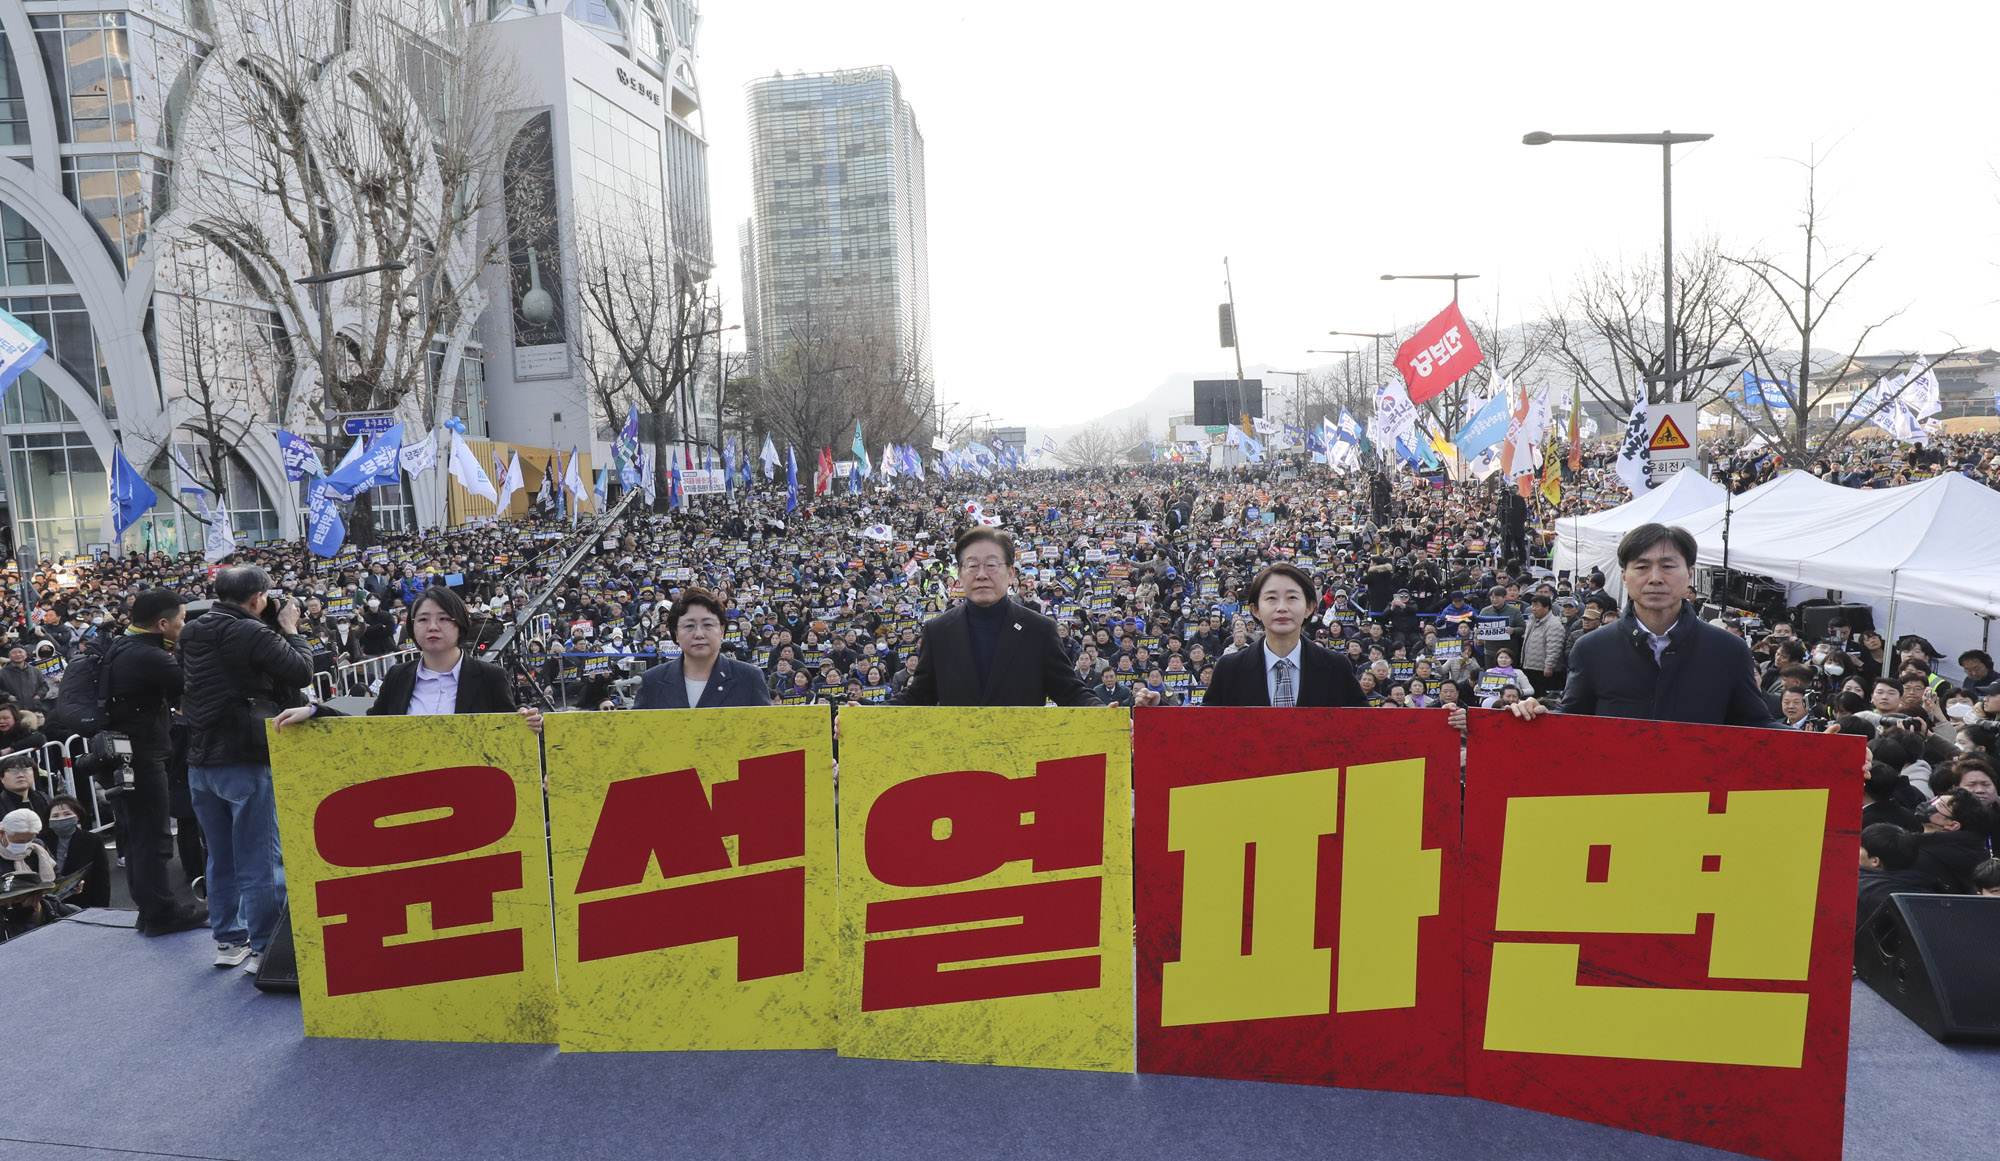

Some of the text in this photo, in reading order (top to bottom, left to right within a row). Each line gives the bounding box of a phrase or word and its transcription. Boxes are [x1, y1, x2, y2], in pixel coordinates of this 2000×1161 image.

[47, 658, 59, 667] 종식
[48, 664, 60, 673] 수호
[314, 749, 1829, 1069] 윤석열 파면
